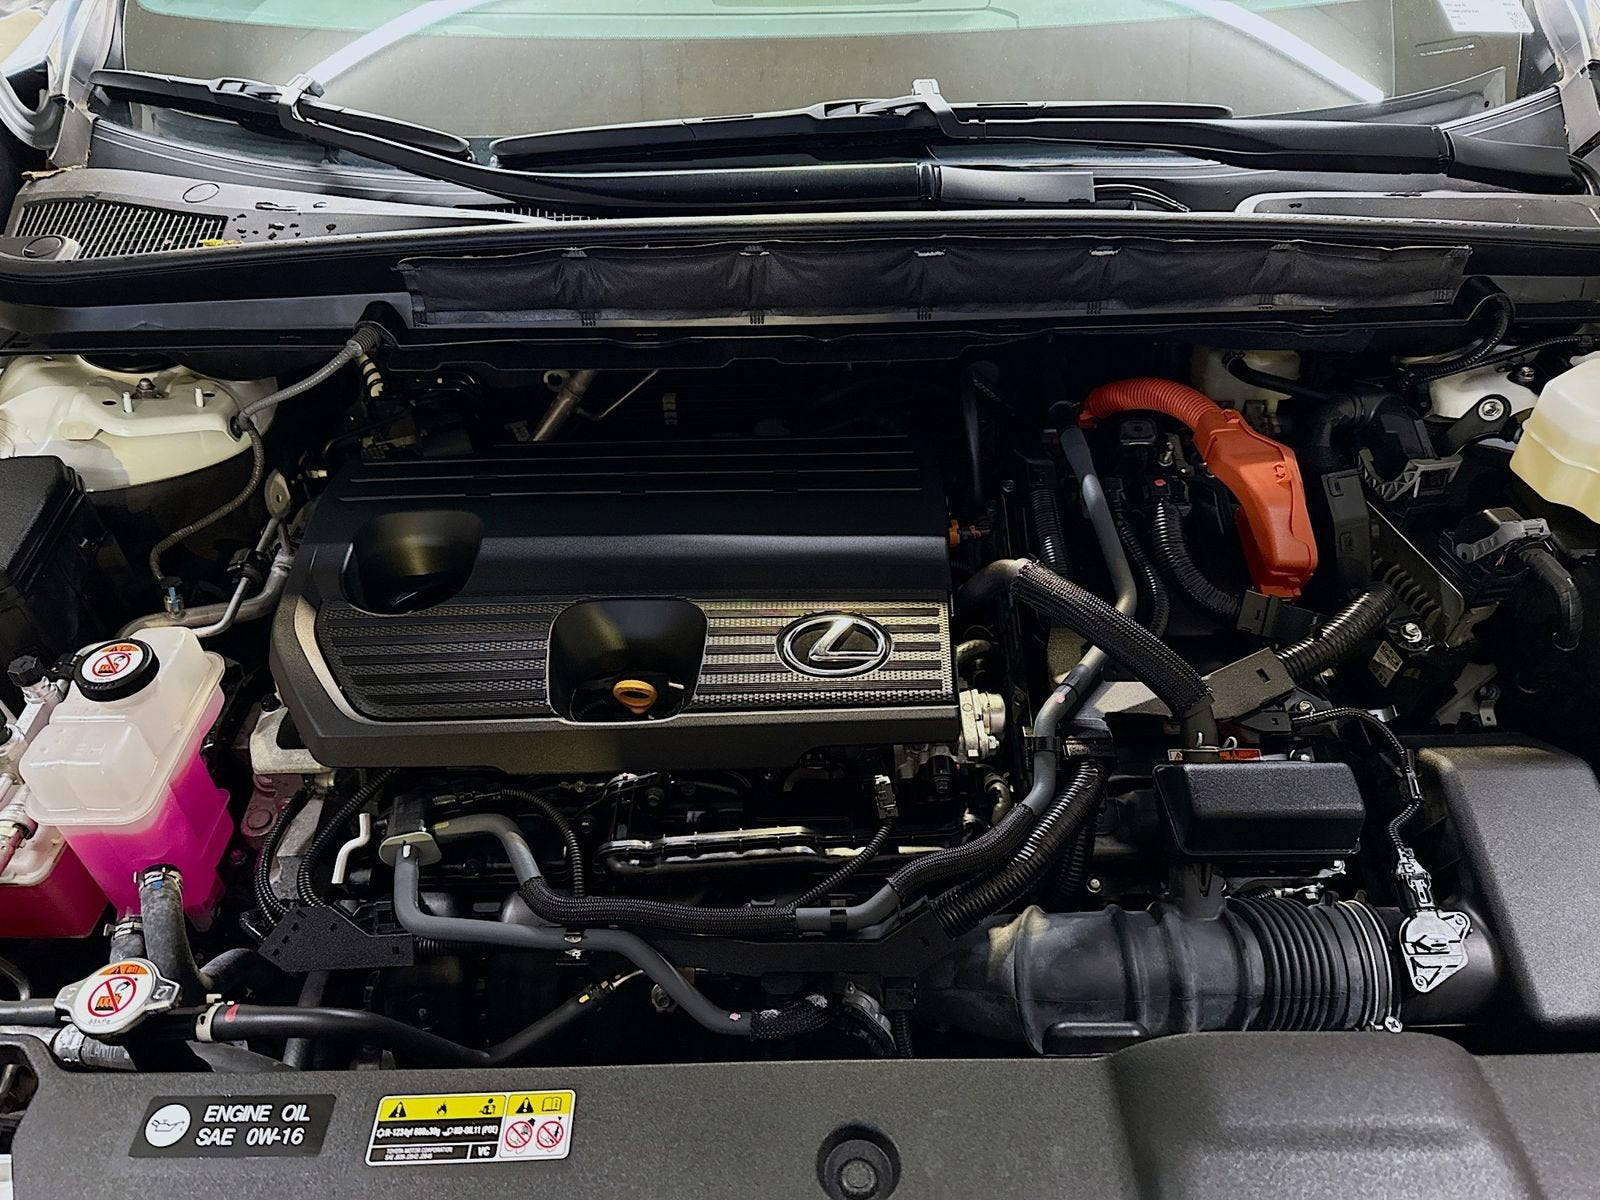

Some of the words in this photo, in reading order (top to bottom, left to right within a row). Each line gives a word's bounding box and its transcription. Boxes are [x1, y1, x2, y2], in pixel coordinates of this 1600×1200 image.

[203, 1104, 273, 1123] ENGINE
[281, 1104, 311, 1122] OIL
[195, 1127, 237, 1147] SAE
[245, 1127, 305, 1146] 0W-16
[477, 1146, 491, 1157] VC
